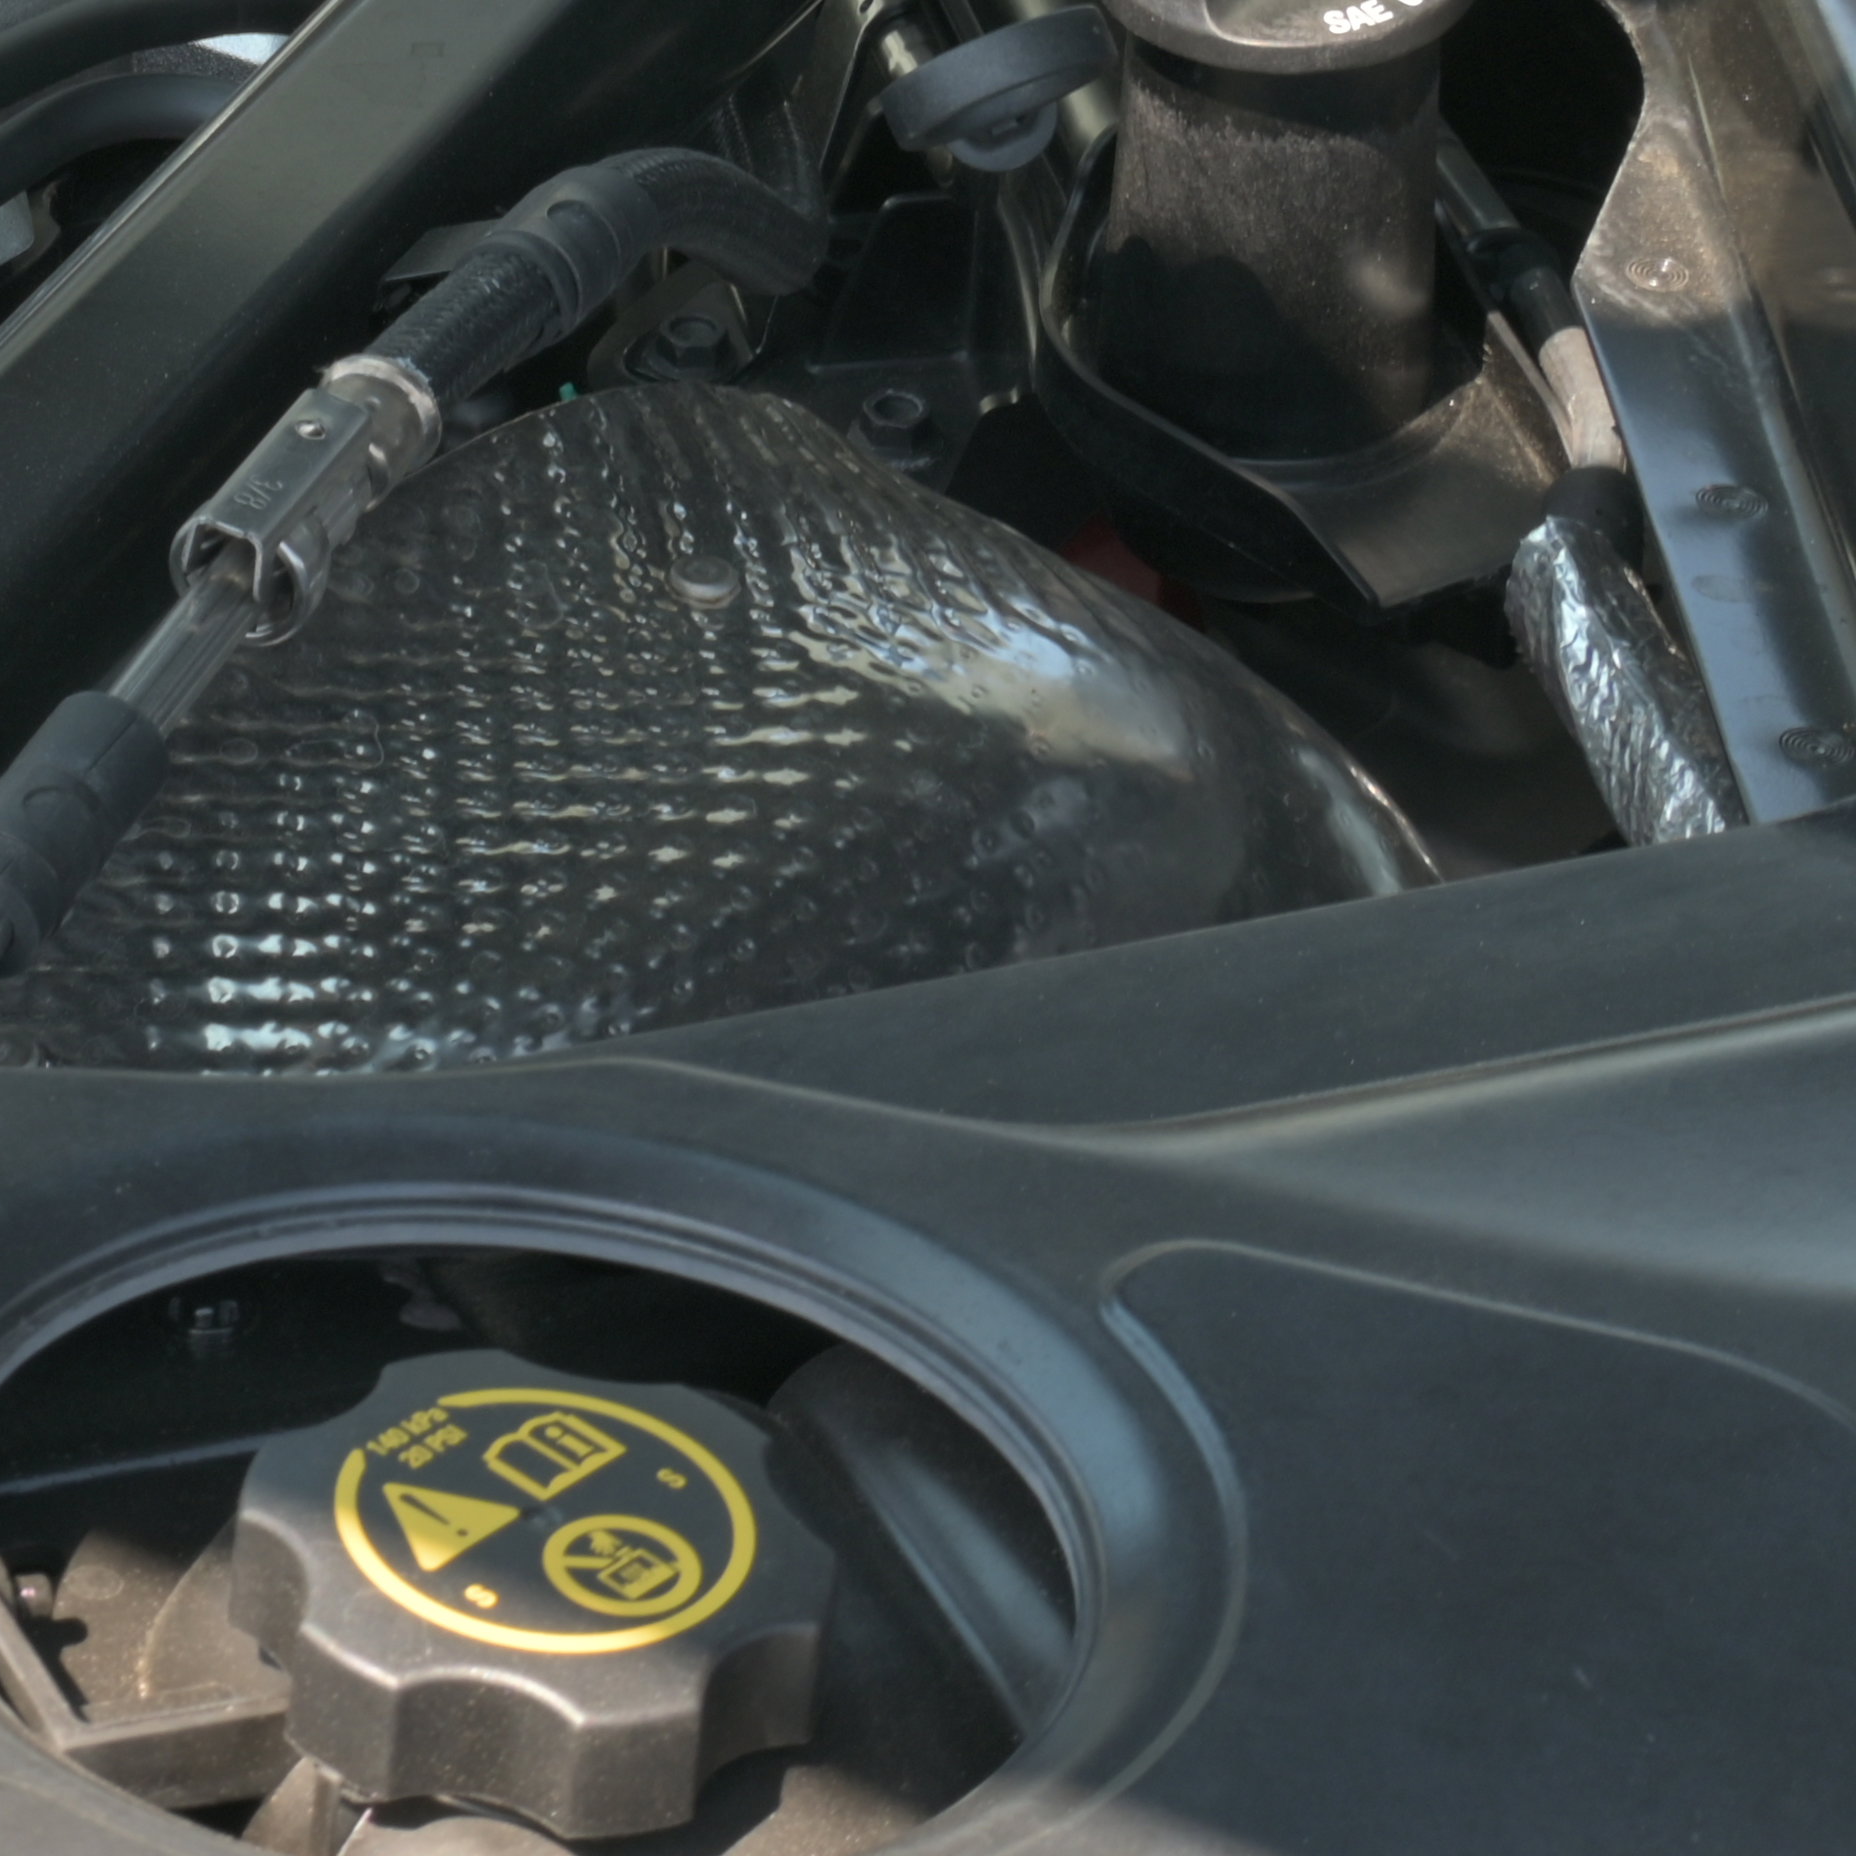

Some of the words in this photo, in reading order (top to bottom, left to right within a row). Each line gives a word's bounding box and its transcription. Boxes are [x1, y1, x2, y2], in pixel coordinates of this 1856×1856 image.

[366, 1426, 412, 1457] 140
[399, 1406, 450, 1436] kPa
[397, 1443, 435, 1471] 20
